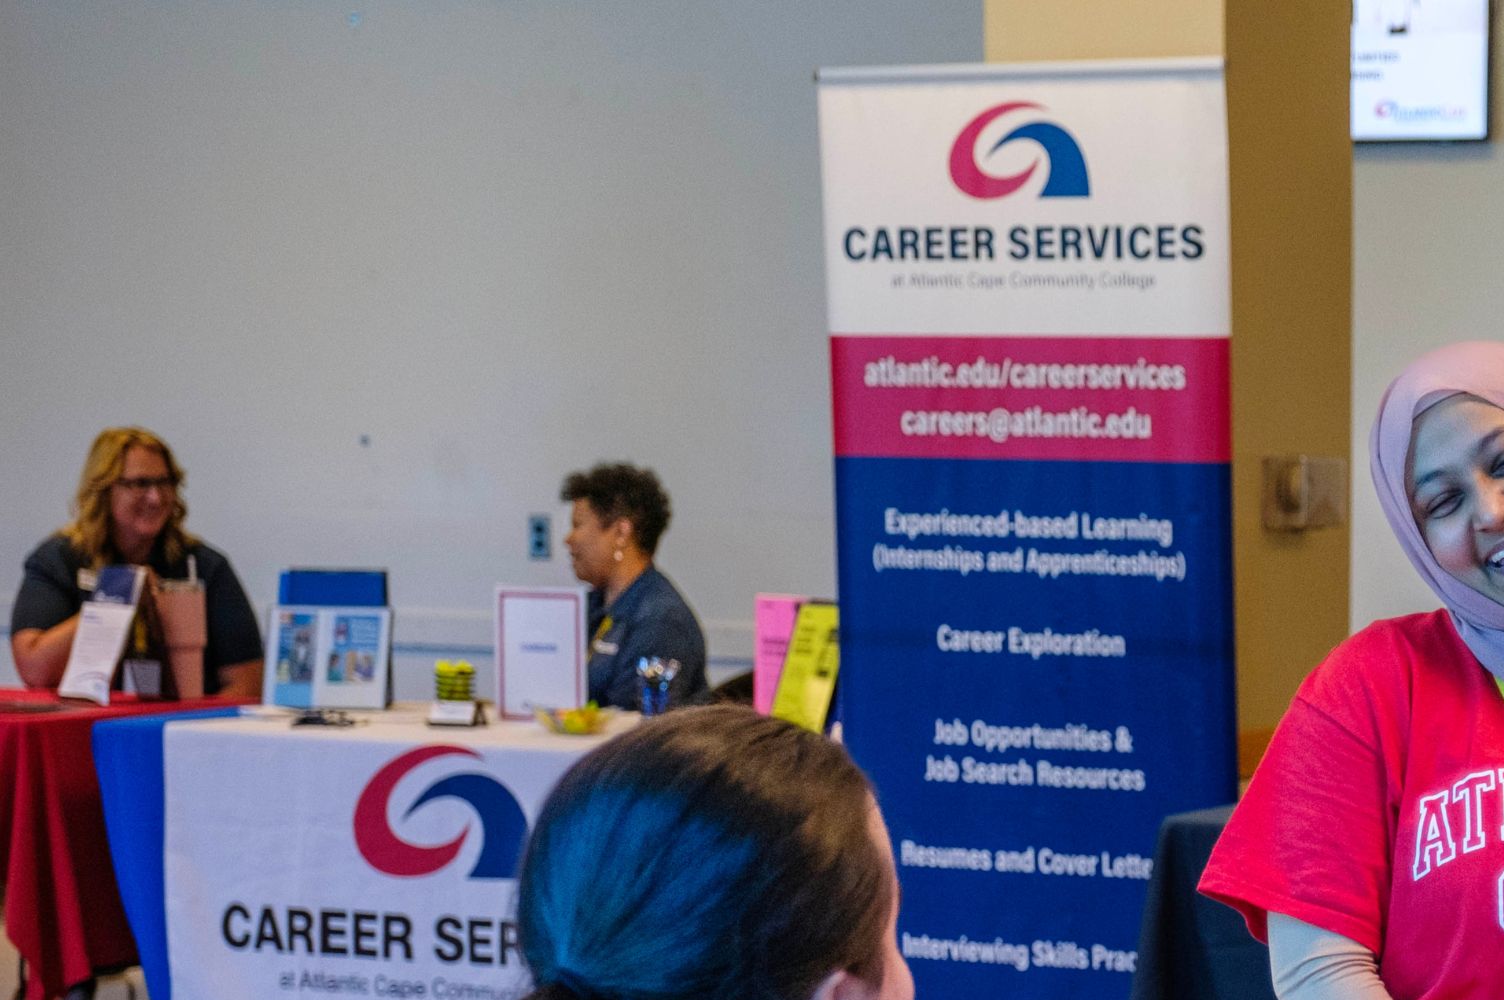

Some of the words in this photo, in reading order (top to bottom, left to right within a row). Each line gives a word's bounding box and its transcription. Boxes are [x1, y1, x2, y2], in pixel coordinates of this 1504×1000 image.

[843, 225, 996, 262] CAREER
[1009, 224, 1206, 261] SERVICES
[891, 274, 905, 288] at
[909, 273, 963, 288] Atlantic
[967, 273, 1004, 290] Cape
[1011, 273, 1095, 291] Community
[1101, 272, 1157, 291] College
[865, 355, 1186, 390] atlantic.edu/careerservices
[900, 406, 1151, 443] careers@atlantic.edu
[884, 507, 1079, 541] Experienced-based
[1081, 513, 1173, 547] Learning
[873, 543, 984, 576] (Internships
[986, 547, 1024, 573] and
[1025, 548, 1187, 582] Apprenticeships)
[936, 624, 1006, 653] Career
[1007, 627, 1127, 660] Exploration
[933, 718, 968, 746] Job
[971, 720, 1112, 753] Opportunities
[1114, 725, 1134, 753] &
[925, 755, 960, 782] Job
[962, 757, 1034, 787] Search
[1036, 760, 1146, 791] Resources
[901, 840, 993, 872] Resumes
[994, 843, 1034, 874] and
[1037, 847, 1097, 877] Cover
[222, 901, 414, 962] CAREER
[903, 932, 1030, 972] Interviewing
[1031, 939, 1089, 971] Skills
[279, 972, 295, 990] at
[300, 972, 369, 994] Atlantic
[374, 974, 427, 1000] Cape
